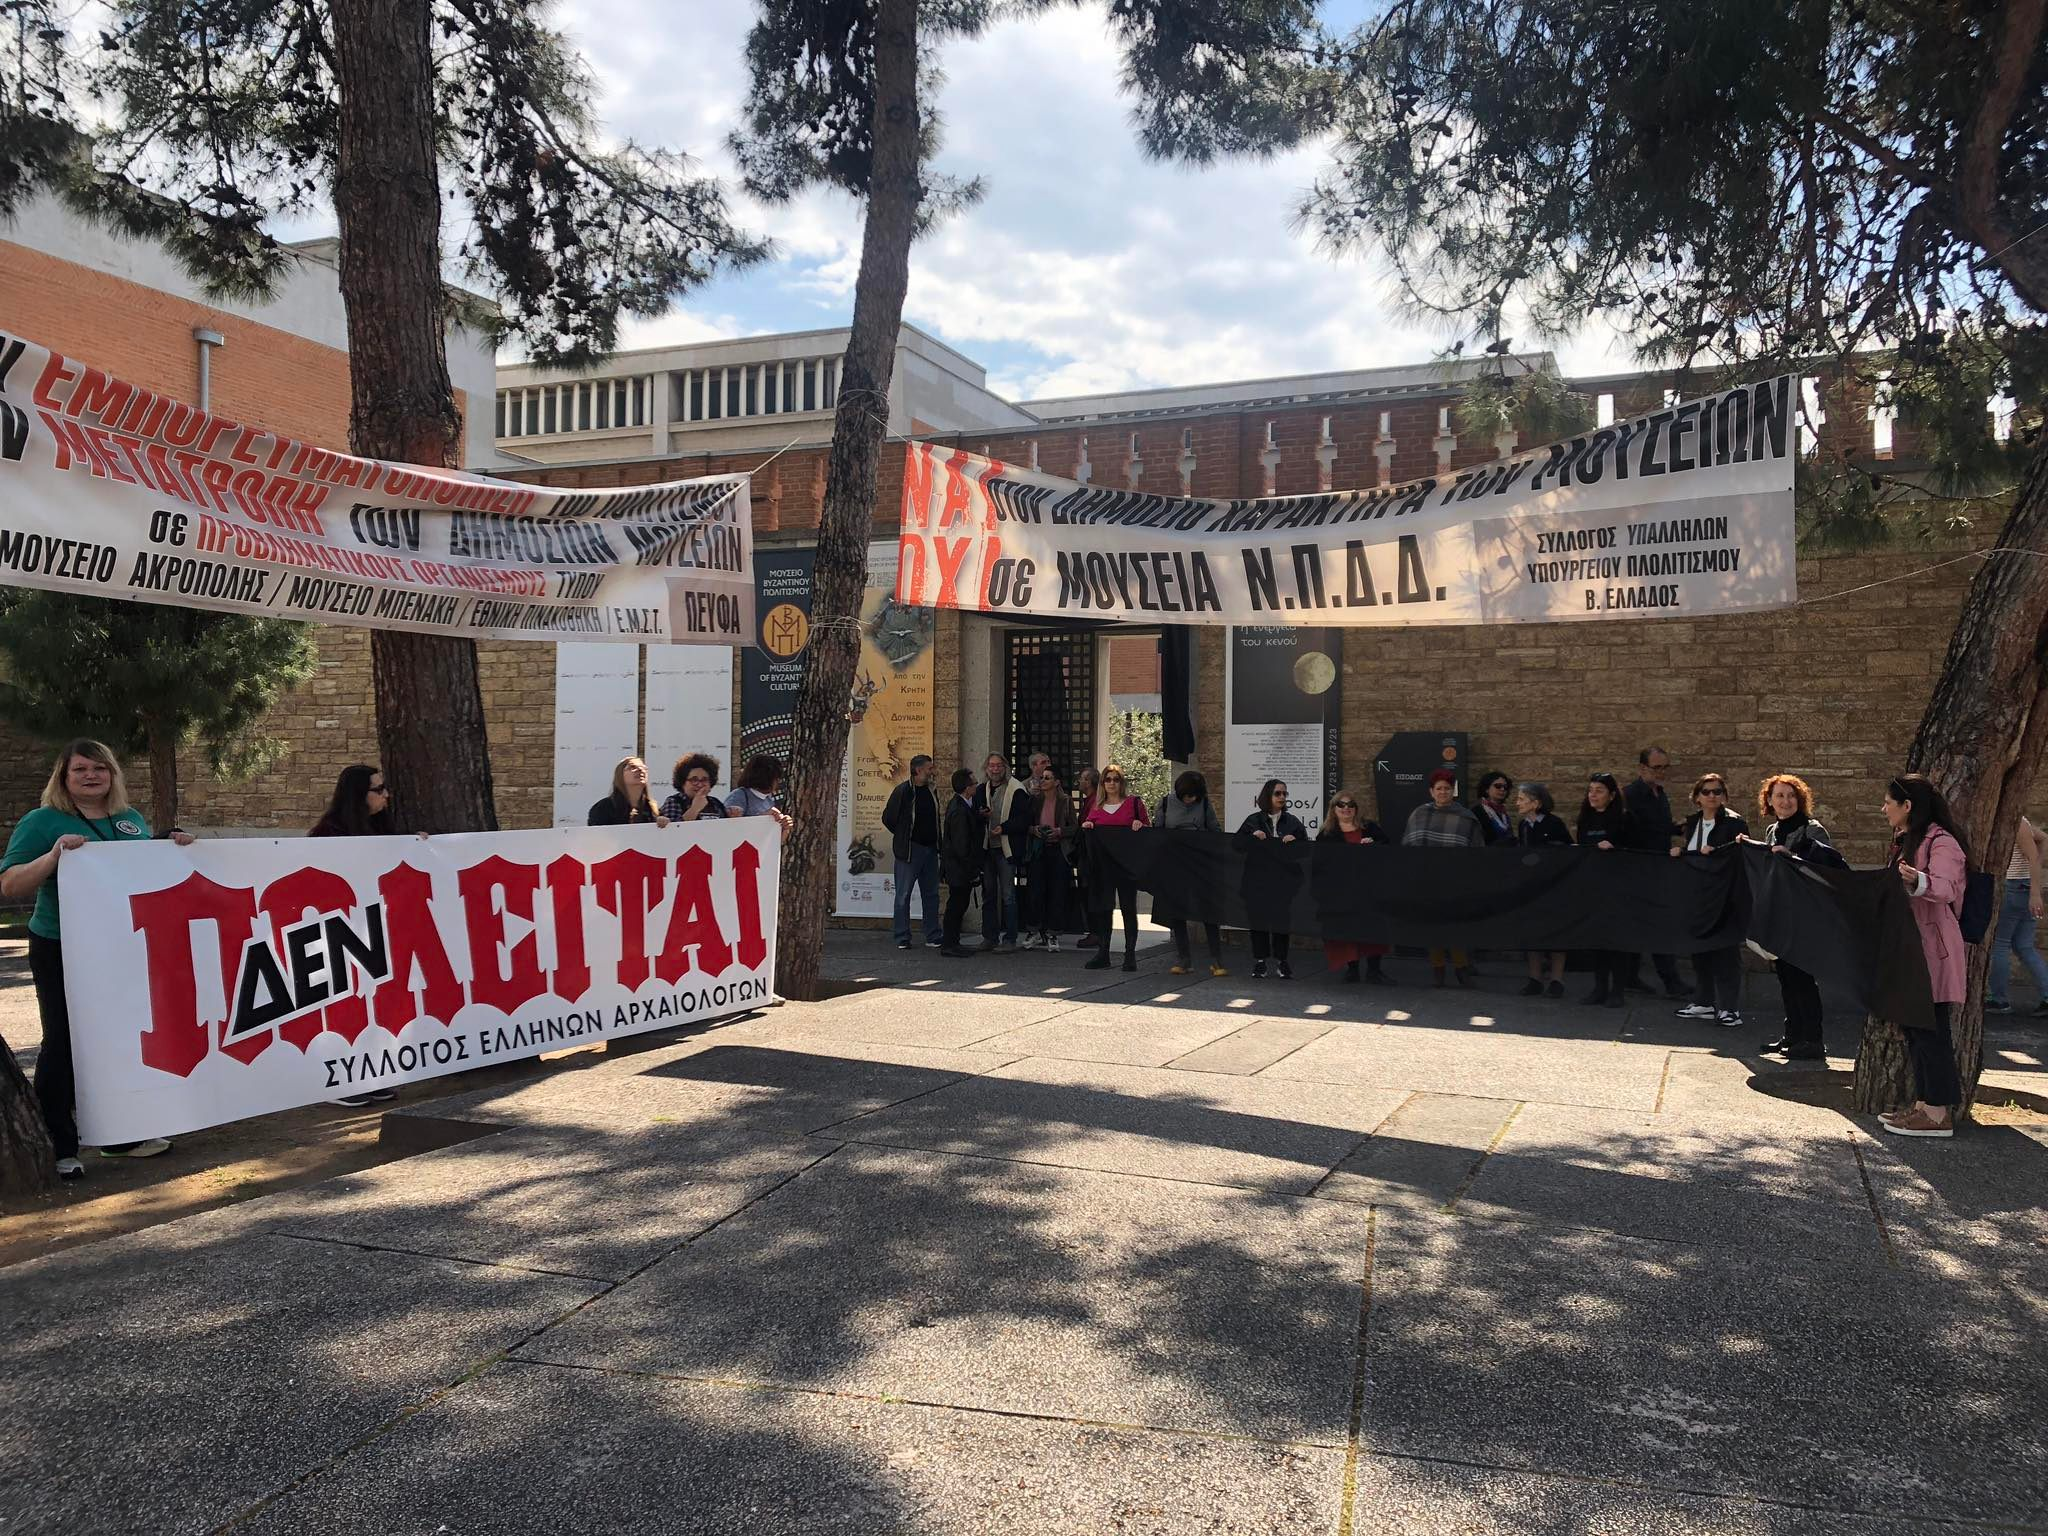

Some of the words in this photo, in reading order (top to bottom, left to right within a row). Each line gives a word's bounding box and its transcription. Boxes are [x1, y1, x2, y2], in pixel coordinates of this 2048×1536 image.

[901, 440, 1005, 531] ΝΑΙ
[987, 479, 1056, 524] στον
[1052, 486, 1215, 531] ΔΗΜΟΣΙΟ
[1204, 479, 1437, 532] ΧΑΡΑΚΤΗΡΑ
[1440, 459, 1534, 506] των
[1531, 375, 1790, 491] ΜΟΥΣΕΙΩΝ
[37, 409, 330, 537] ΜΕΤΑΤΡΟΠΗ
[350, 503, 419, 551] των
[450, 510, 620, 565] ΔΗΜΟΣΙΩΝ
[623, 523, 743, 573] ΜΟΥΣΕΙΩΝ
[149, 509, 188, 547] σε
[196, 512, 413, 584] ΠΡΟΒΛΗΜΑΤΙΚΟΥΣ
[411, 558, 546, 598] ΟΡΓΑΝΙΣΜΟΥΣ
[556, 570, 606, 600] ΤΥΠΟΥ
[1537, 526, 1617, 553] ΣΥΛΛΟΓΟΣ
[1627, 516, 1728, 546] ΥΠΑΛΛΗΛΩΝ
[0, 529, 117, 582] ΜΟΥΣΕΙΟ
[128, 551, 270, 604] ΑΚΡΟΠΟΛΗΣ
[285, 571, 375, 618] ΜΟΥΣΕΙΟ
[372, 585, 460, 626] ΜΠΕΝΑΚΗ
[469, 599, 522, 629] ΕΘΝΙΚΗ
[520, 604, 603, 633] ΠΙΝΑΚΟΘΗΚΗ
[614, 607, 663, 634] Ε.Μ.Σ.Τ.
[763, 578, 810, 587] ΒΥΖΑΝΤΙΝΟΥ
[769, 569, 803, 577] ΜΟΥΣΕΙΟ
[896, 533, 1003, 612] ΟΧΙ
[988, 558, 1036, 607] σε
[1057, 550, 1223, 612] ΜΟΥΣΕΙΑ
[1241, 534, 1447, 611] Ν.Π.Δ.Δ.
[1528, 556, 1621, 584] ΥΠΟΥΡΓΕΙΟΥ
[684, 590, 741, 634] ΠΕΥΦΑ
[763, 587, 810, 597] ΠΟΛΙΤΙΣΜΟΥ
[1585, 589, 1601, 610] Β.
[1606, 584, 1680, 610] ΕΛΛΑΔΟΣ
[760, 674, 769, 682] OF
[771, 674, 802, 682] BYZANT
[769, 664, 802, 672] MUSEUM
[227, 902, 391, 1038] ΔΕΝ
[324, 1034, 469, 1088] ΣΥΛΛΟΓΟΣ
[480, 1008, 604, 1054] ΕΛΛΗΝΩΝ
[613, 976, 768, 1029] ΑΡΧΑΙΟΛΟΓΩΝ
